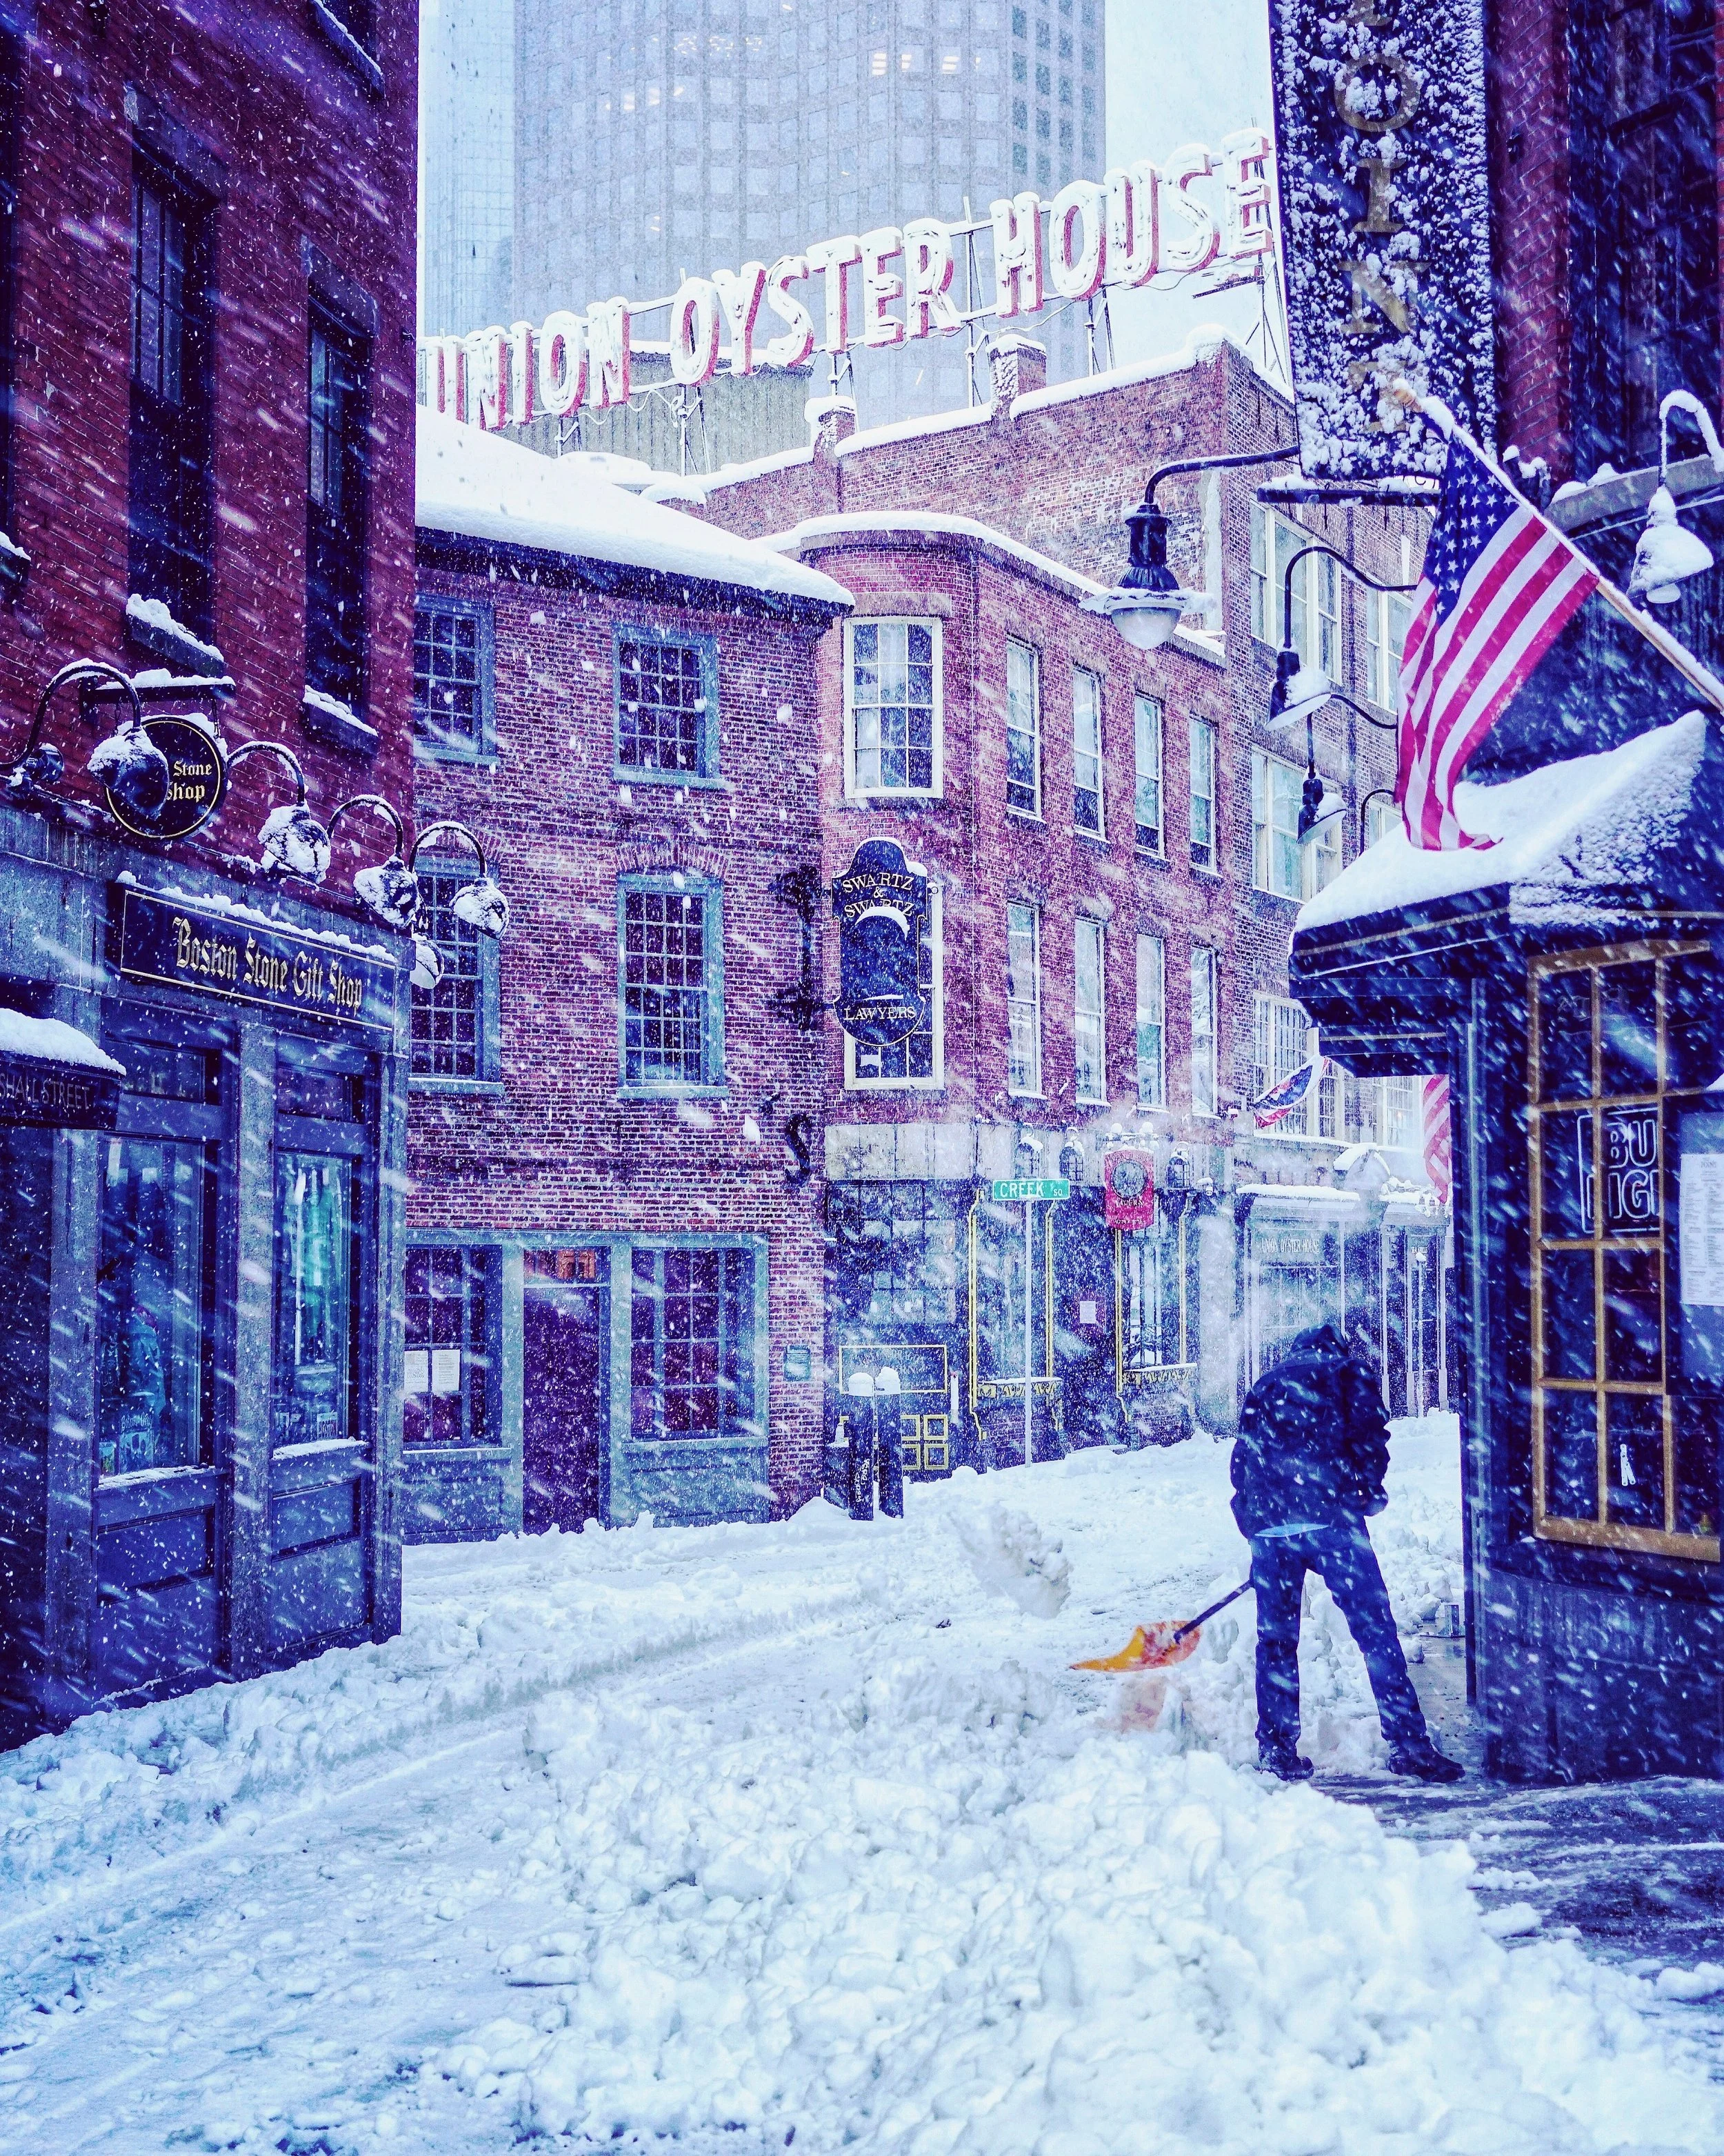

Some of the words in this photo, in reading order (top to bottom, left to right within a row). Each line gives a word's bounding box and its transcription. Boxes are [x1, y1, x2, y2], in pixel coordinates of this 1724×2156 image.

[425, 297, 630, 430] UNION
[670, 218, 962, 386] OYSTER
[989, 128, 1272, 301] HOUSE
[173, 759, 212, 777] Stone
[842, 872, 914, 892] SWARTZ
[873, 886, 883, 898] &
[844, 898, 915, 917] SWARTZ
[173, 917, 237, 981] Boston
[243, 932, 288, 992] Stone
[292, 950, 323, 1001] Gift
[328, 959, 363, 1017] Shop
[843, 1006, 916, 1020] LAWYERS
[41, 1077, 90, 1110] STREET
[1000, 1181, 1044, 1198] CREEK
[1261, 1238, 1279, 1252] UNION
[1280, 1238, 1301, 1252] OYSTER
[1303, 1239, 1320, 1253] HOUSE
